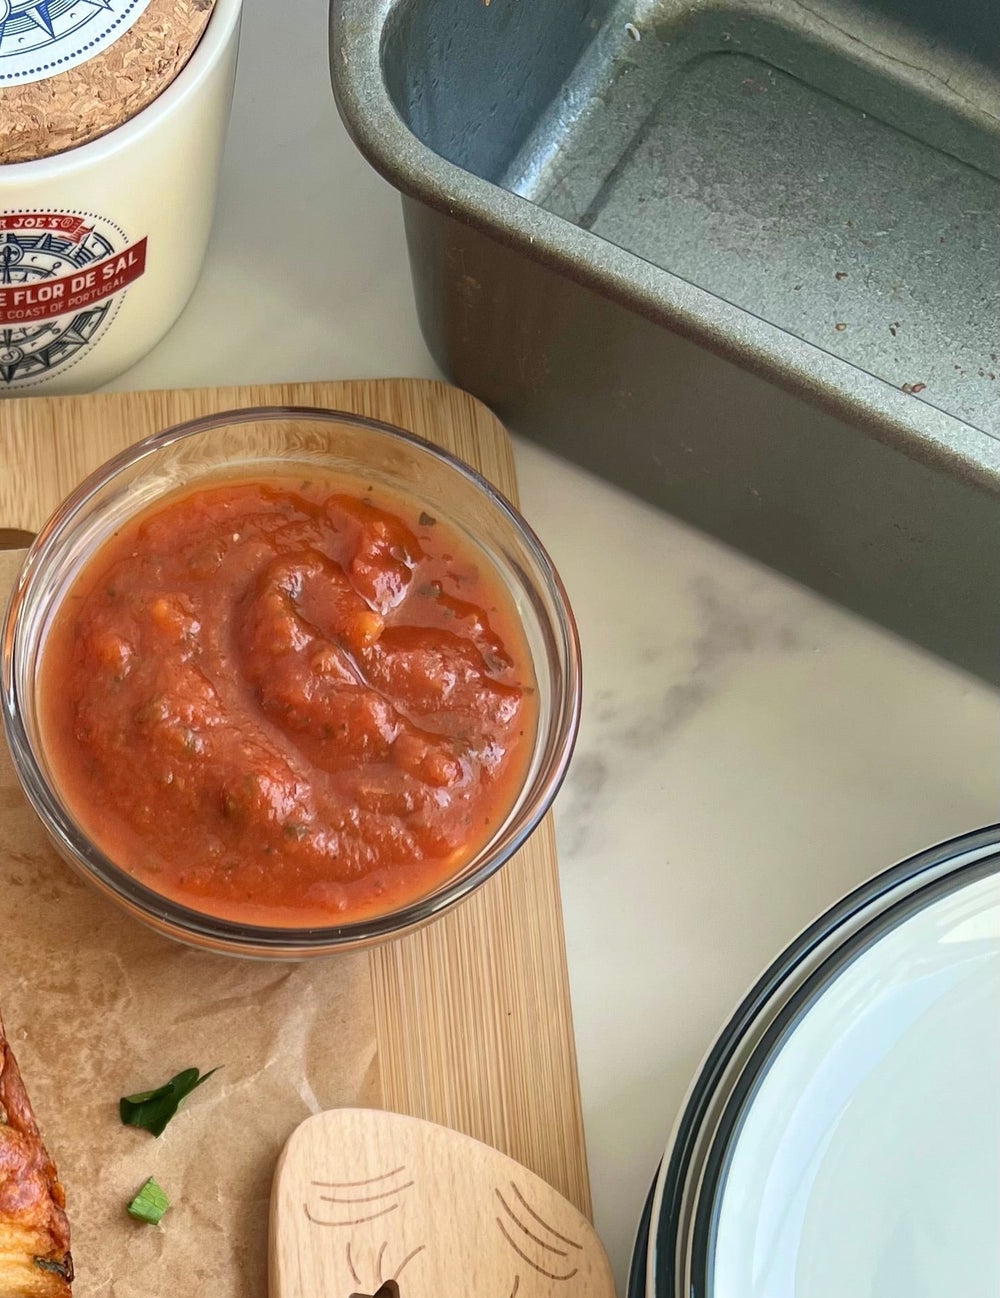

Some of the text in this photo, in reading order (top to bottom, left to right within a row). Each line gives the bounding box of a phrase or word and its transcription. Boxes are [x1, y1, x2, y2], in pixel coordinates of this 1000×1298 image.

[8, 307, 46, 320] COAST
[51, 301, 64, 313] OF
[68, 276, 126, 307] PORTUGAL
[14, 285, 64, 305] FLOR
[71, 274, 95, 294] DE
[102, 252, 138, 278] SAL
